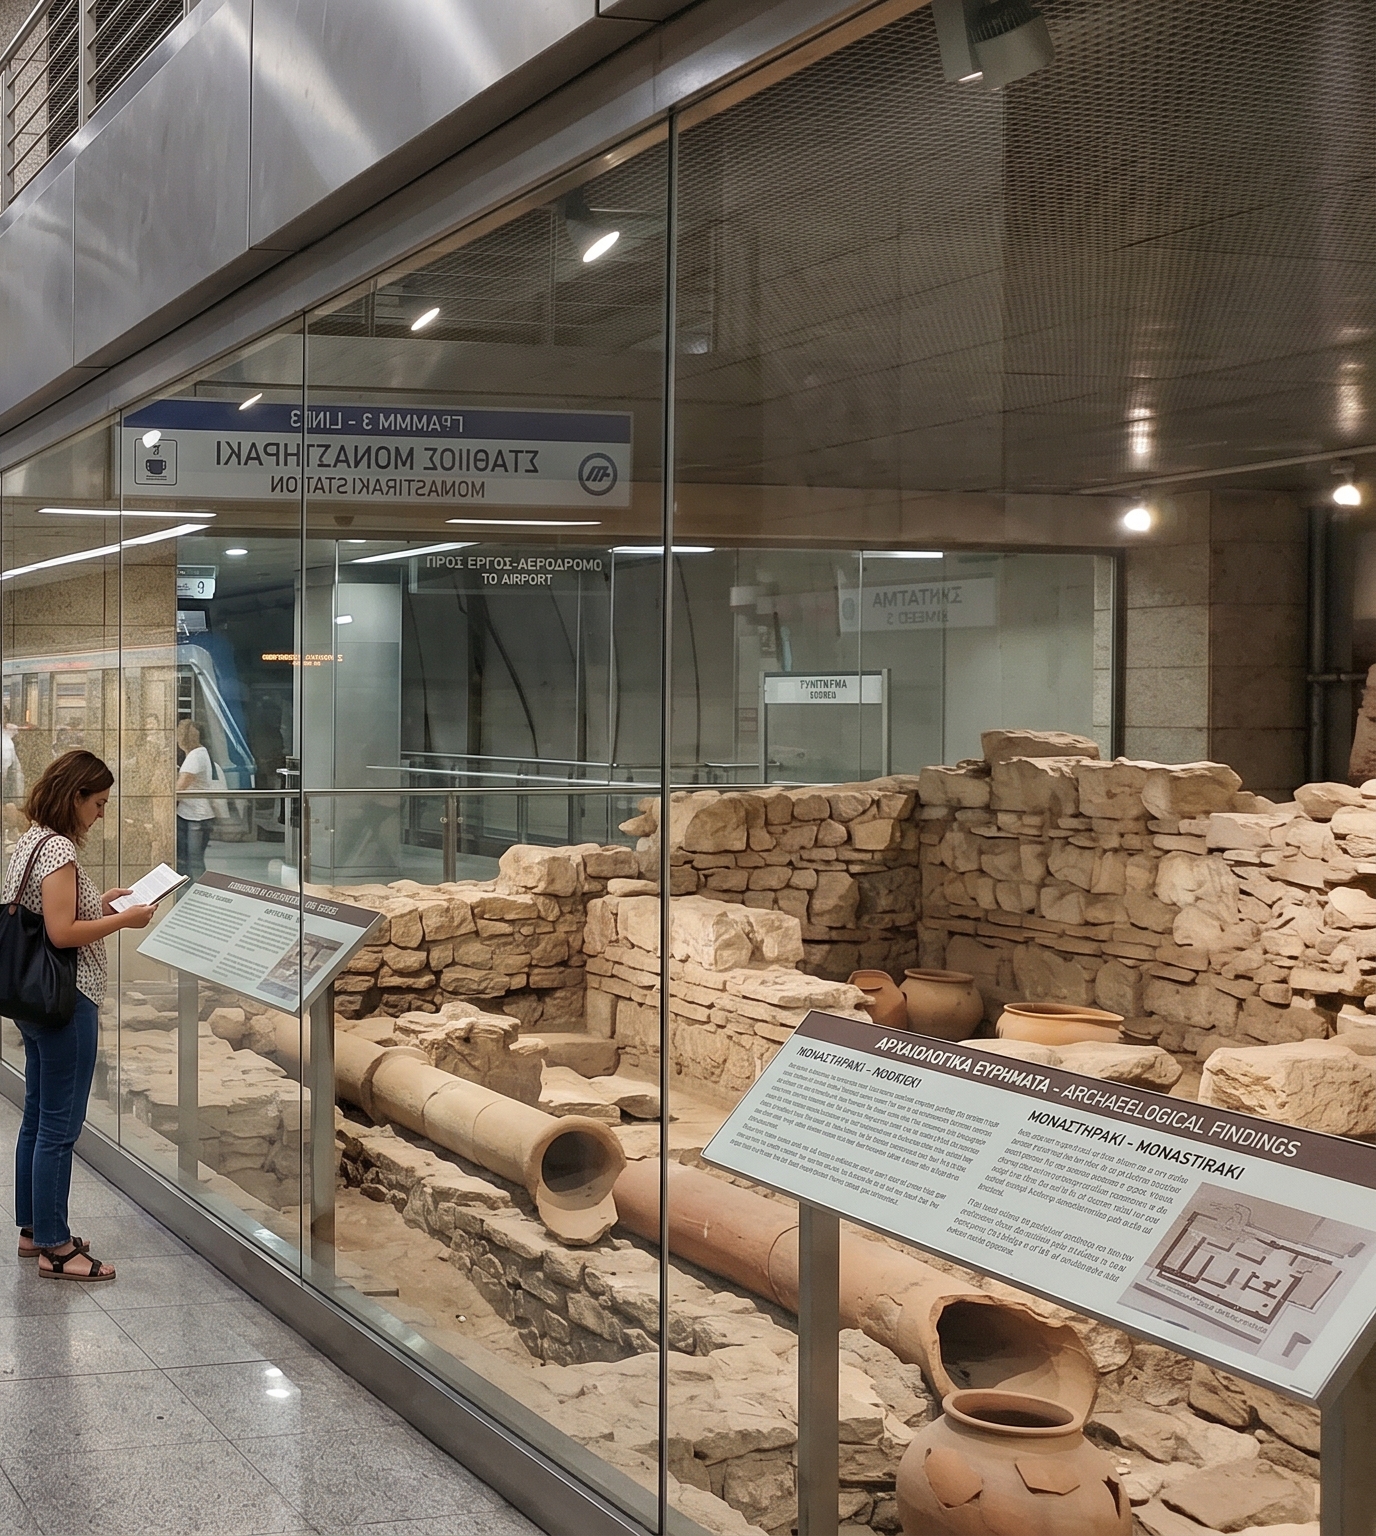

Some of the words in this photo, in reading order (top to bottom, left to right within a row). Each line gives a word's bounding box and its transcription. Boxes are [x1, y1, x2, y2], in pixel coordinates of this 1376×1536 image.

[482, 573, 498, 584] TO
[501, 574, 553, 585] AIRPORT
[874, 1036, 971, 1073] ΑΡΧΑΙΟΛΟΓΙΚΑ
[972, 1060, 1049, 1093] ΕΥΡΗΜΑΤΑ
[1208, 1121, 1302, 1158] FINDINGS
[1027, 1110, 1126, 1147] ΜΟΝΑΣΤΗΡΑΚΙ
[1134, 1139, 1246, 1180] MONASTIRAKI
